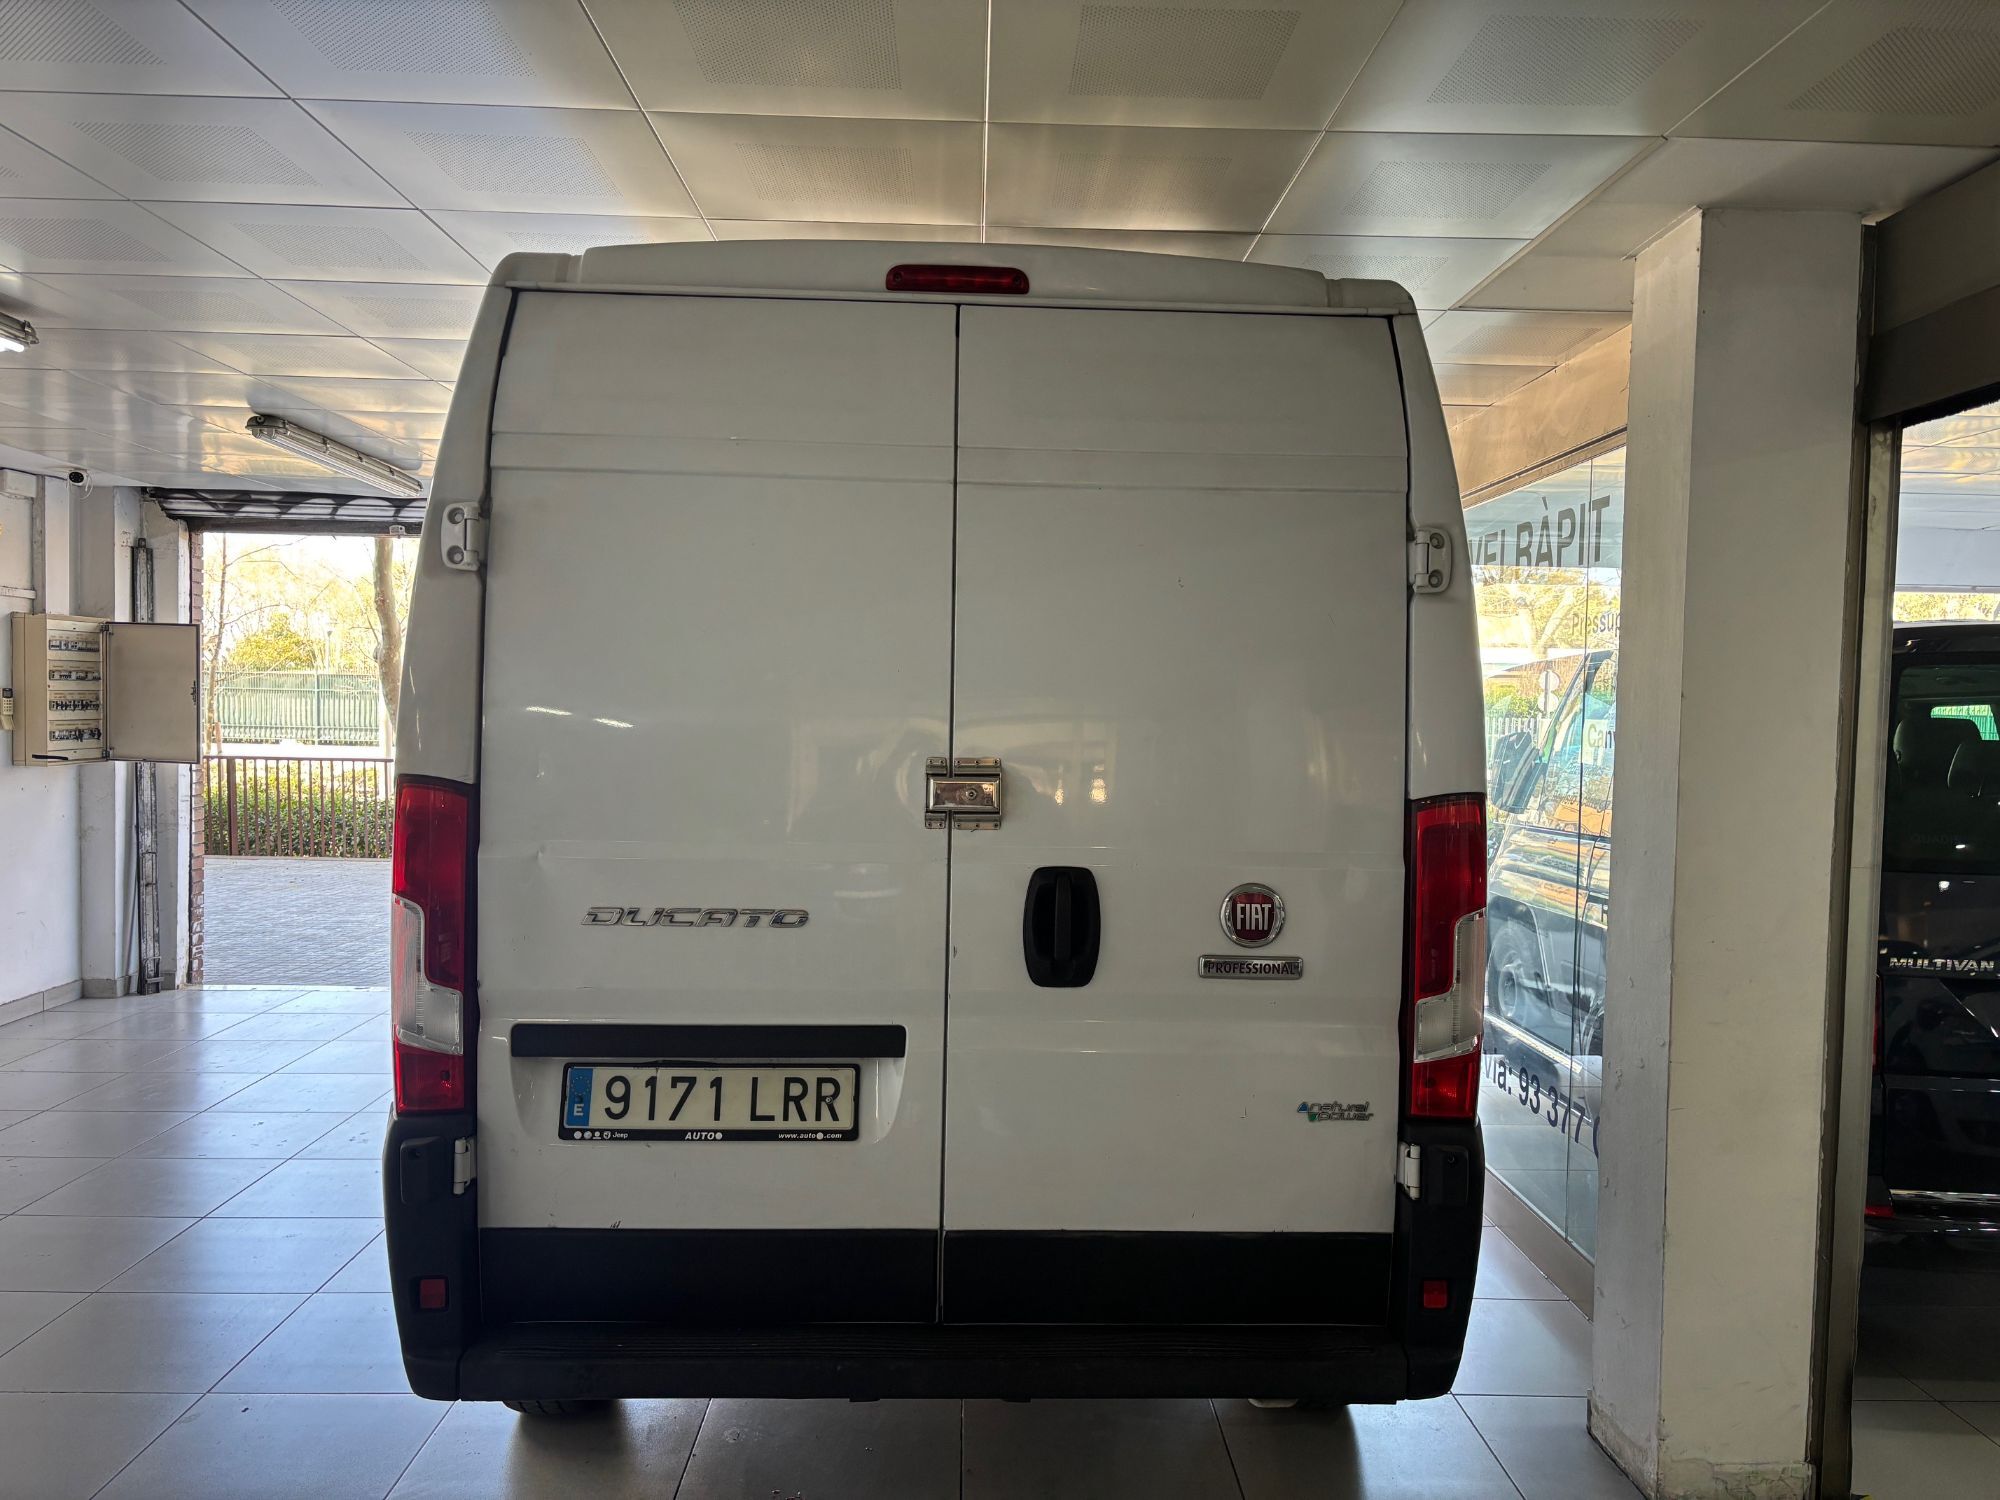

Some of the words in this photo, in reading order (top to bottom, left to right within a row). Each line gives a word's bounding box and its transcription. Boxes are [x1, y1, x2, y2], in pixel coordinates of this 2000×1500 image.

[1515, 495, 1611, 568] RÀPIT
[1588, 723, 1616, 749] Can
[581, 906, 809, 929] DUCATO
[1236, 903, 1272, 931] FIAT
[1207, 962, 1296, 975] PROFESSIONAL
[1889, 957, 1995, 972] MULTIVAN
[604, 1075, 723, 1122] 9171
[750, 1077, 841, 1122] LRR
[1518, 1067, 1541, 1114] 93
[573, 1104, 584, 1117] E
